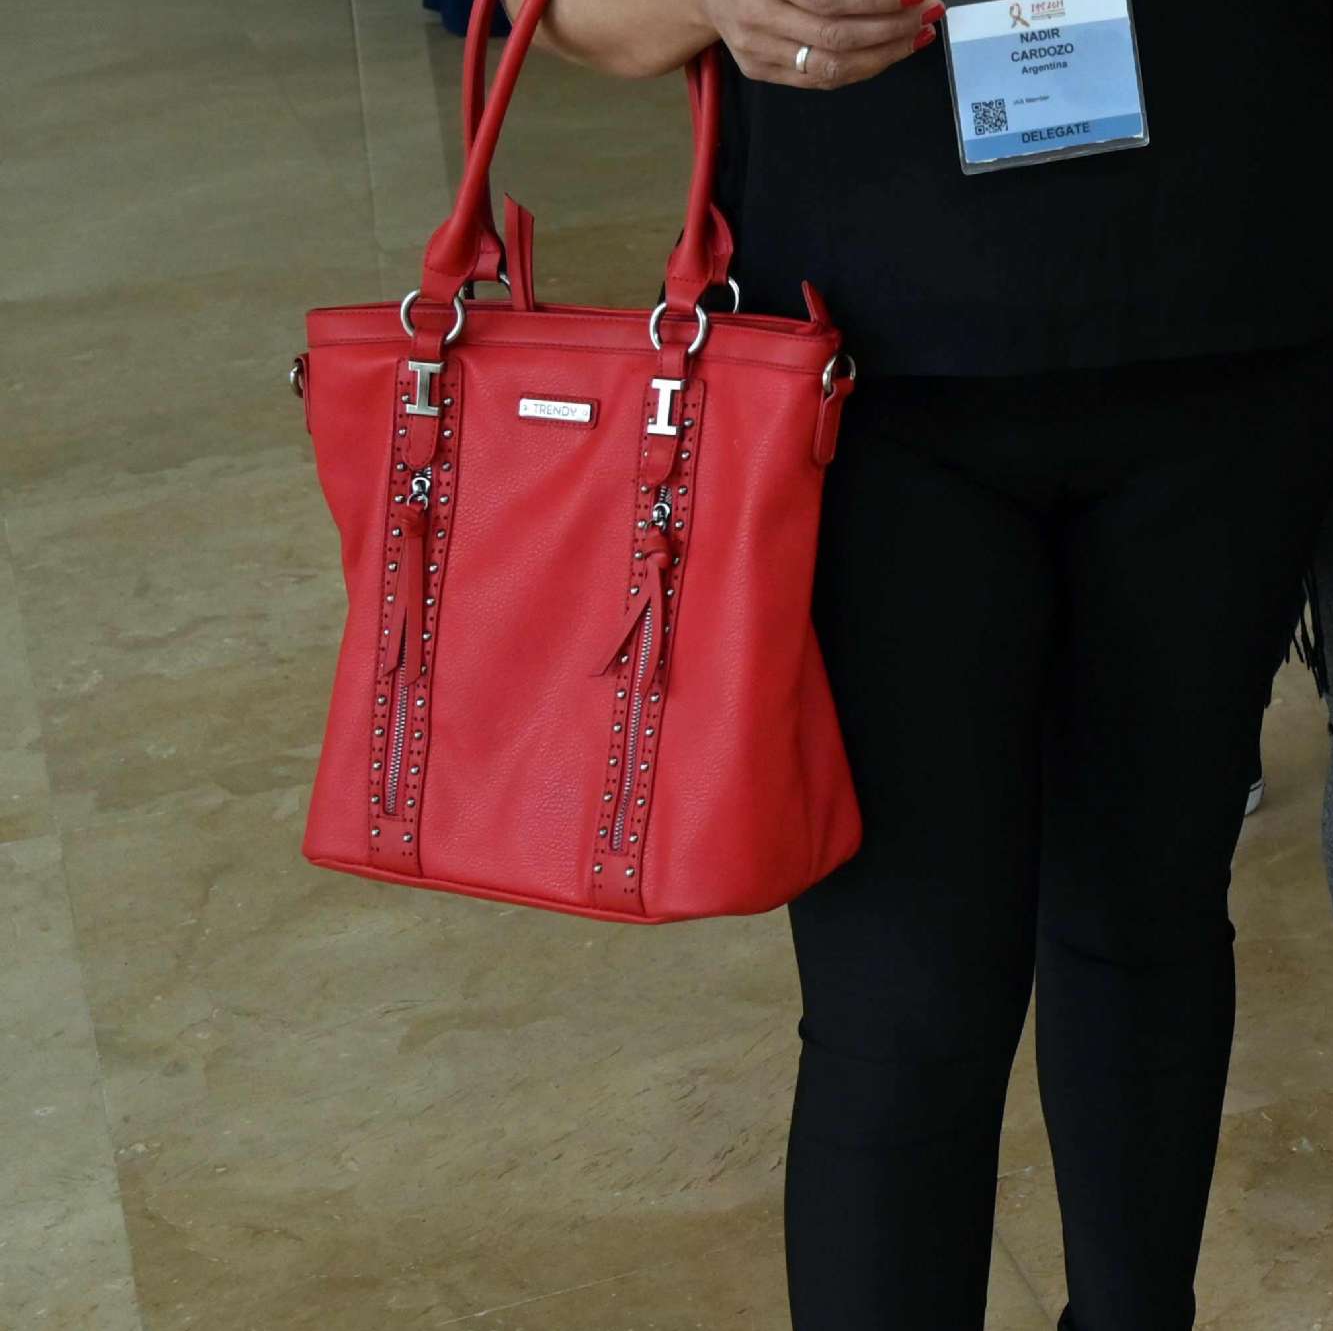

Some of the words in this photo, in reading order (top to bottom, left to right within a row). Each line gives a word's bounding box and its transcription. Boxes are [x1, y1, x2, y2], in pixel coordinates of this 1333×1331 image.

[1020, 28, 1060, 43] NADIR
[1011, 43, 1074, 62] CARDOZO
[1022, 61, 1068, 75] Argentina
[1021, 122, 1091, 144] DELEGATE
[533, 403, 577, 417] TRENDY
